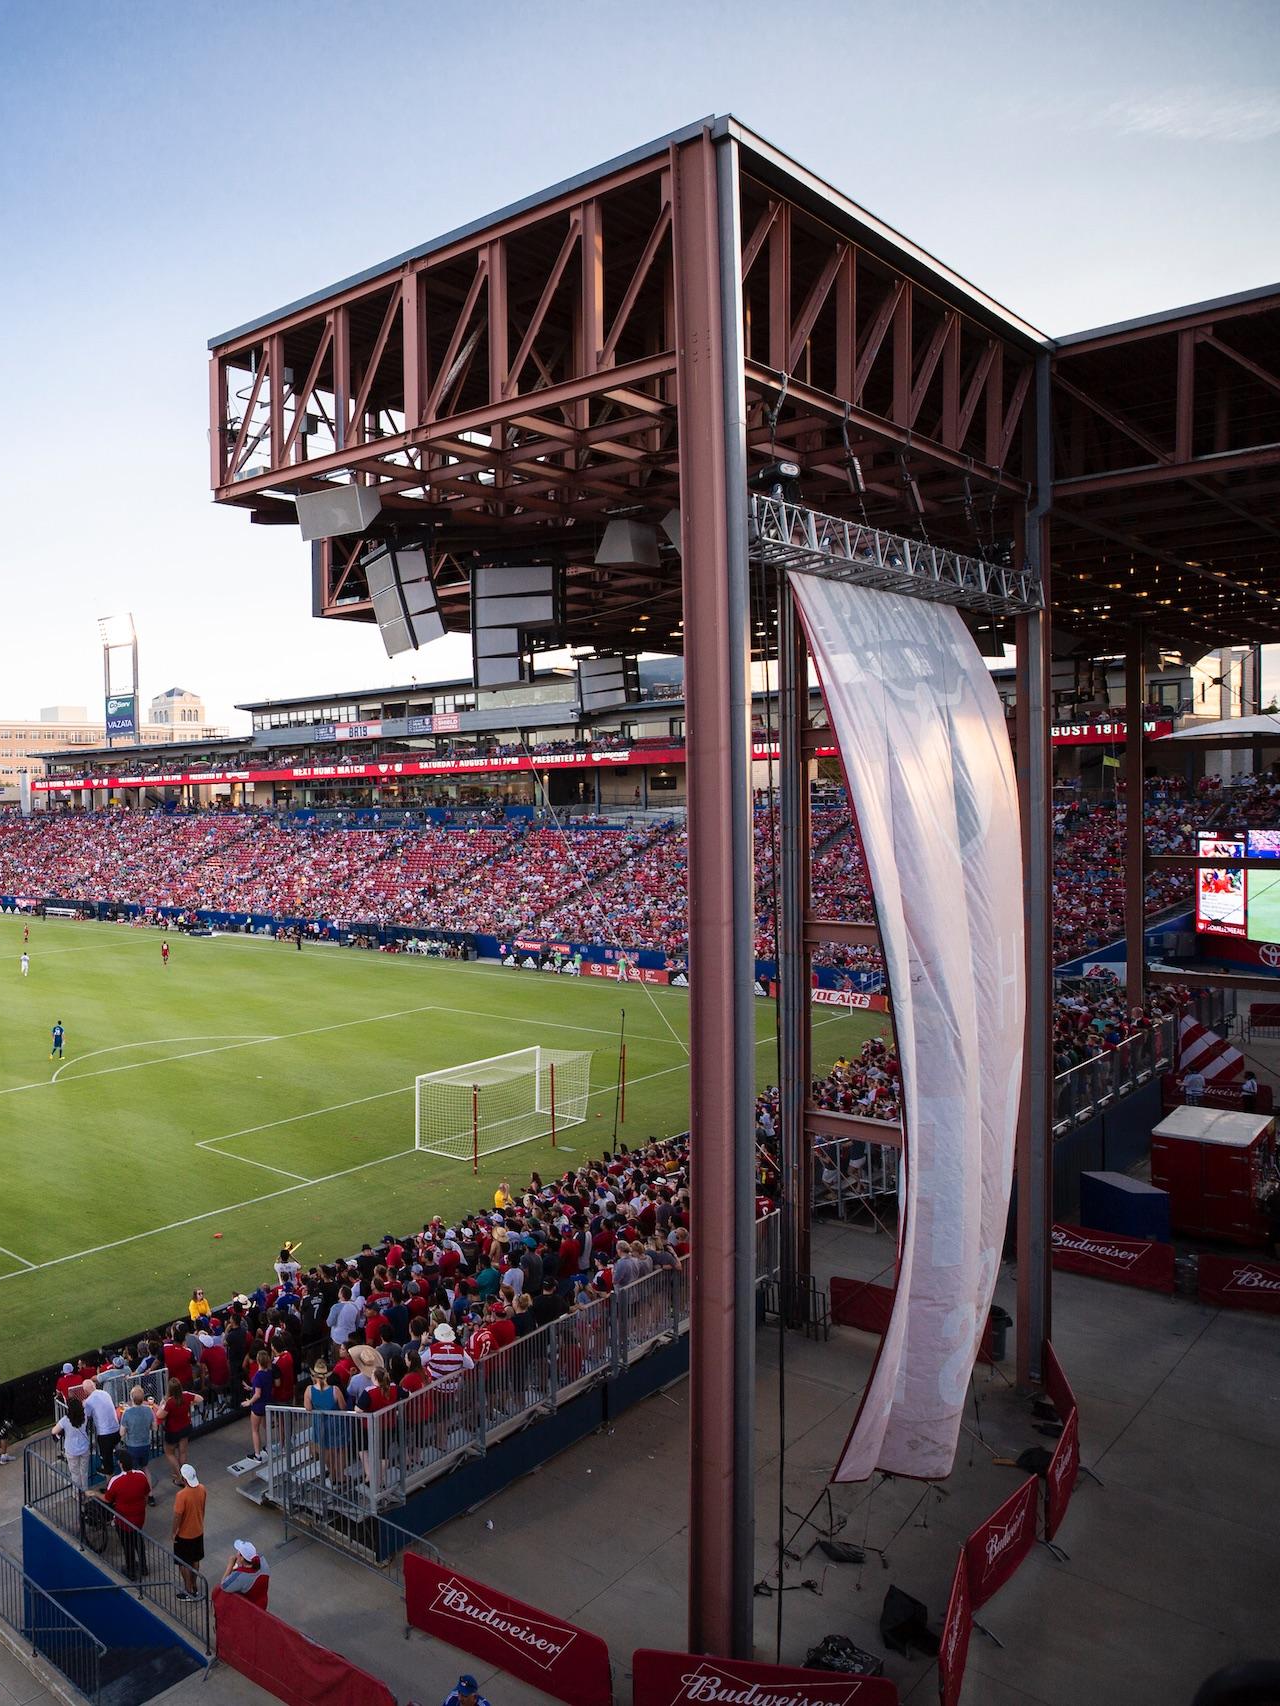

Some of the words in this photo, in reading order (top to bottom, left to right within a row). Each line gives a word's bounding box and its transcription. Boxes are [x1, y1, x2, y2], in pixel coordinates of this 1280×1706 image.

[108, 720, 133, 729] VAZATA
[1051, 725, 1090, 736] GUST
[459, 758, 489, 768] AUGUST
[532, 754, 575, 764] PRESENTED
[576, 753, 587, 762] BY
[293, 767, 312, 777] NEXT
[313, 766, 336, 776] HOME
[337, 765, 365, 775] MATCH
[524, 942, 542, 951] TOYOT
[1052, 1231, 1138, 1261] Budweiser
[438, 1583, 562, 1655] Budweiser
